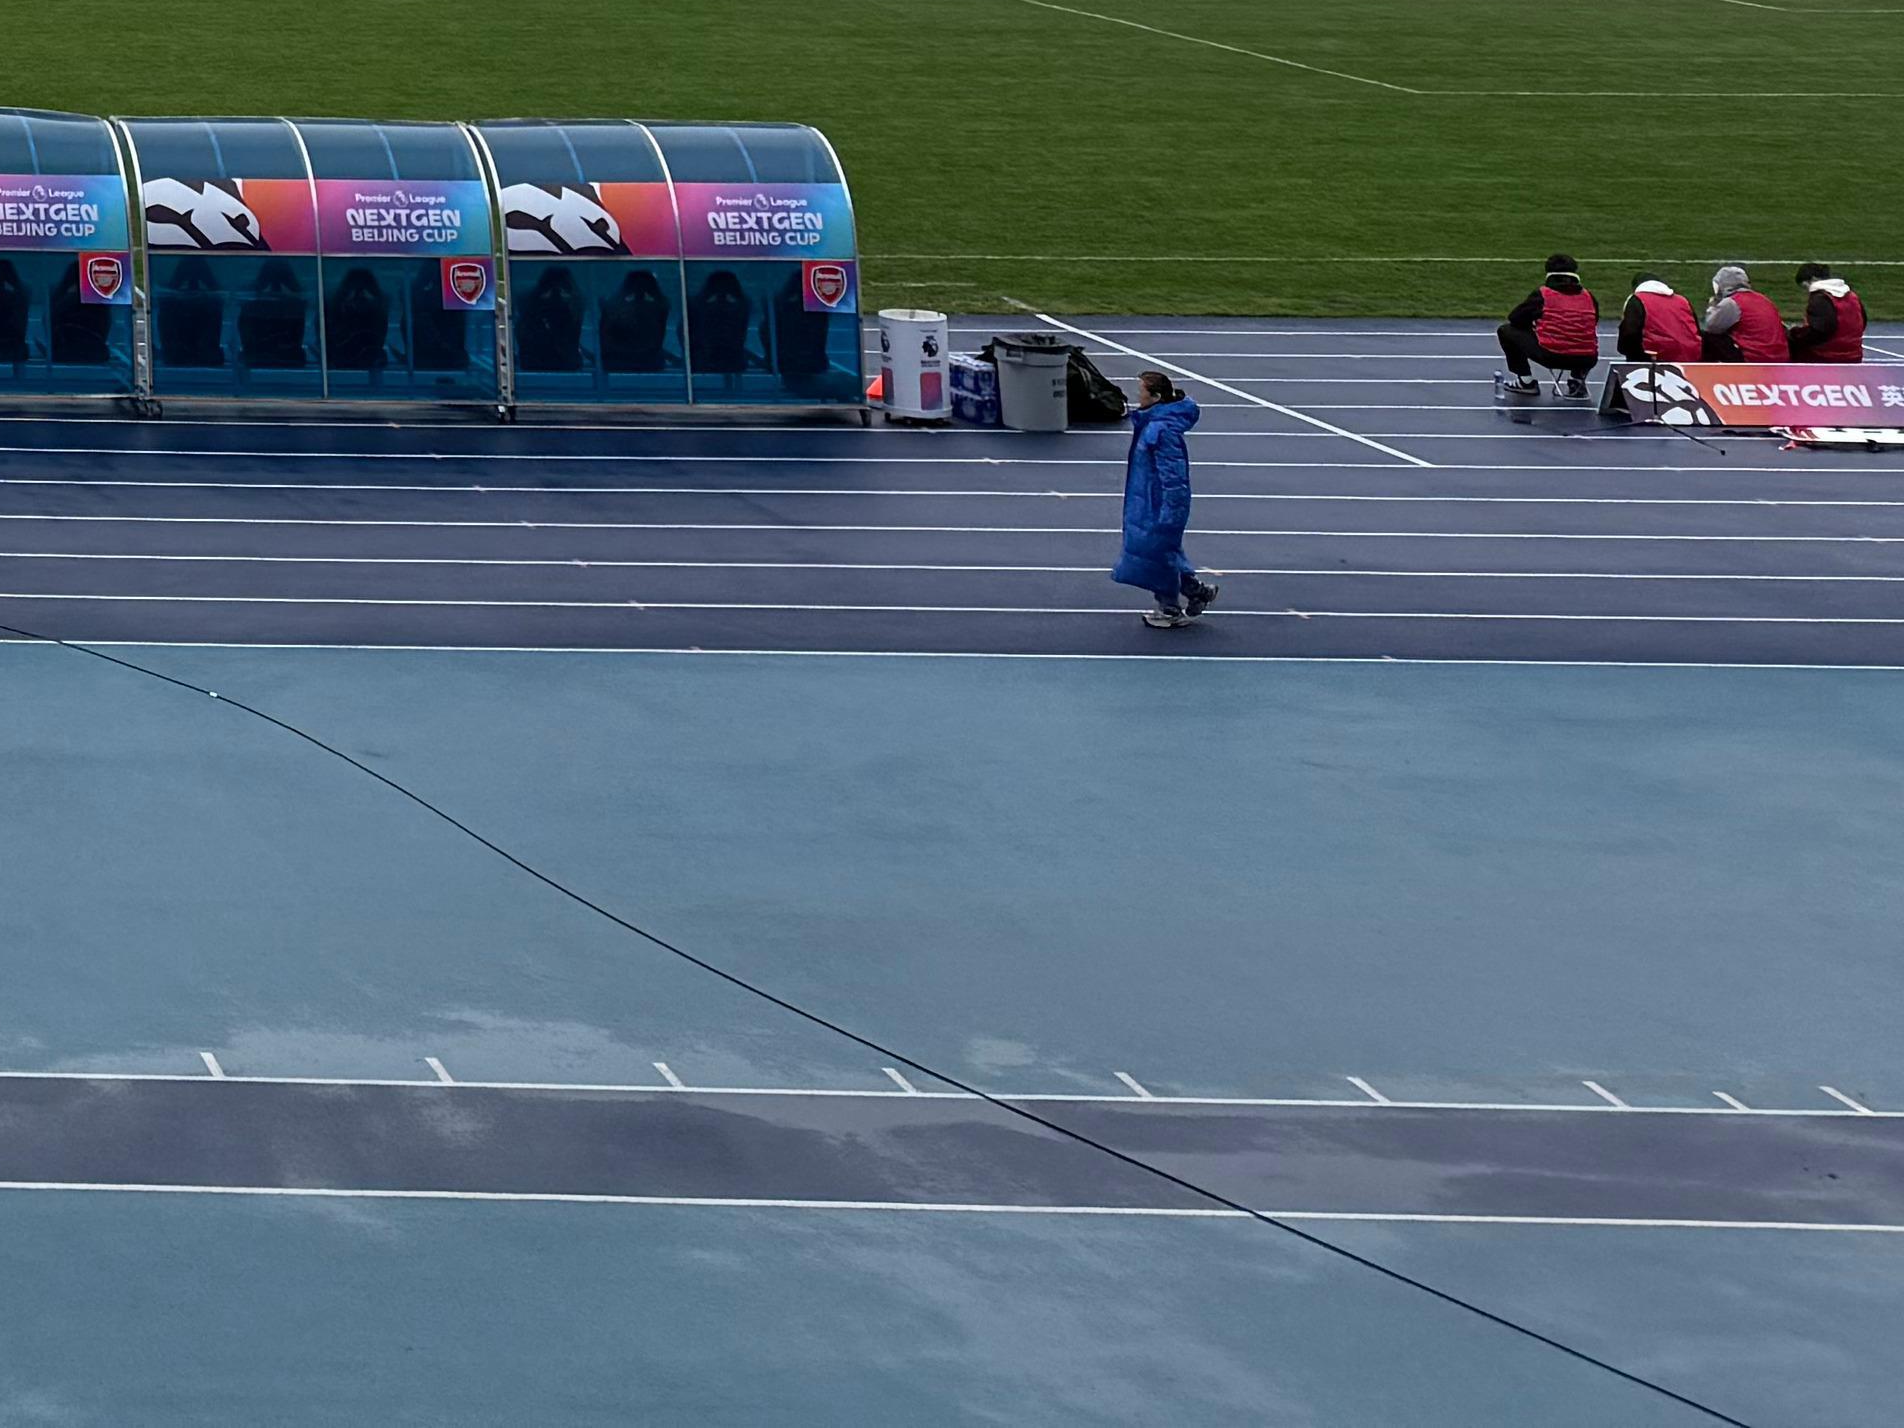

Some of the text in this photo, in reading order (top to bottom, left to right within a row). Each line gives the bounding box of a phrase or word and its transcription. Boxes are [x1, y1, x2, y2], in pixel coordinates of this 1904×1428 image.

[48, 188, 84, 200] League
[355, 193, 446, 206] Premier League
[716, 196, 808, 208] Premier League
[345, 208, 461, 227] NEXTGEN
[707, 212, 823, 230] NEXTGEN
[60, 223, 95, 237] CUP
[351, 228, 458, 243] BEIJING CUP
[713, 231, 821, 246] BEIJING CUP
[1713, 383, 1873, 407] NEXTGEN
